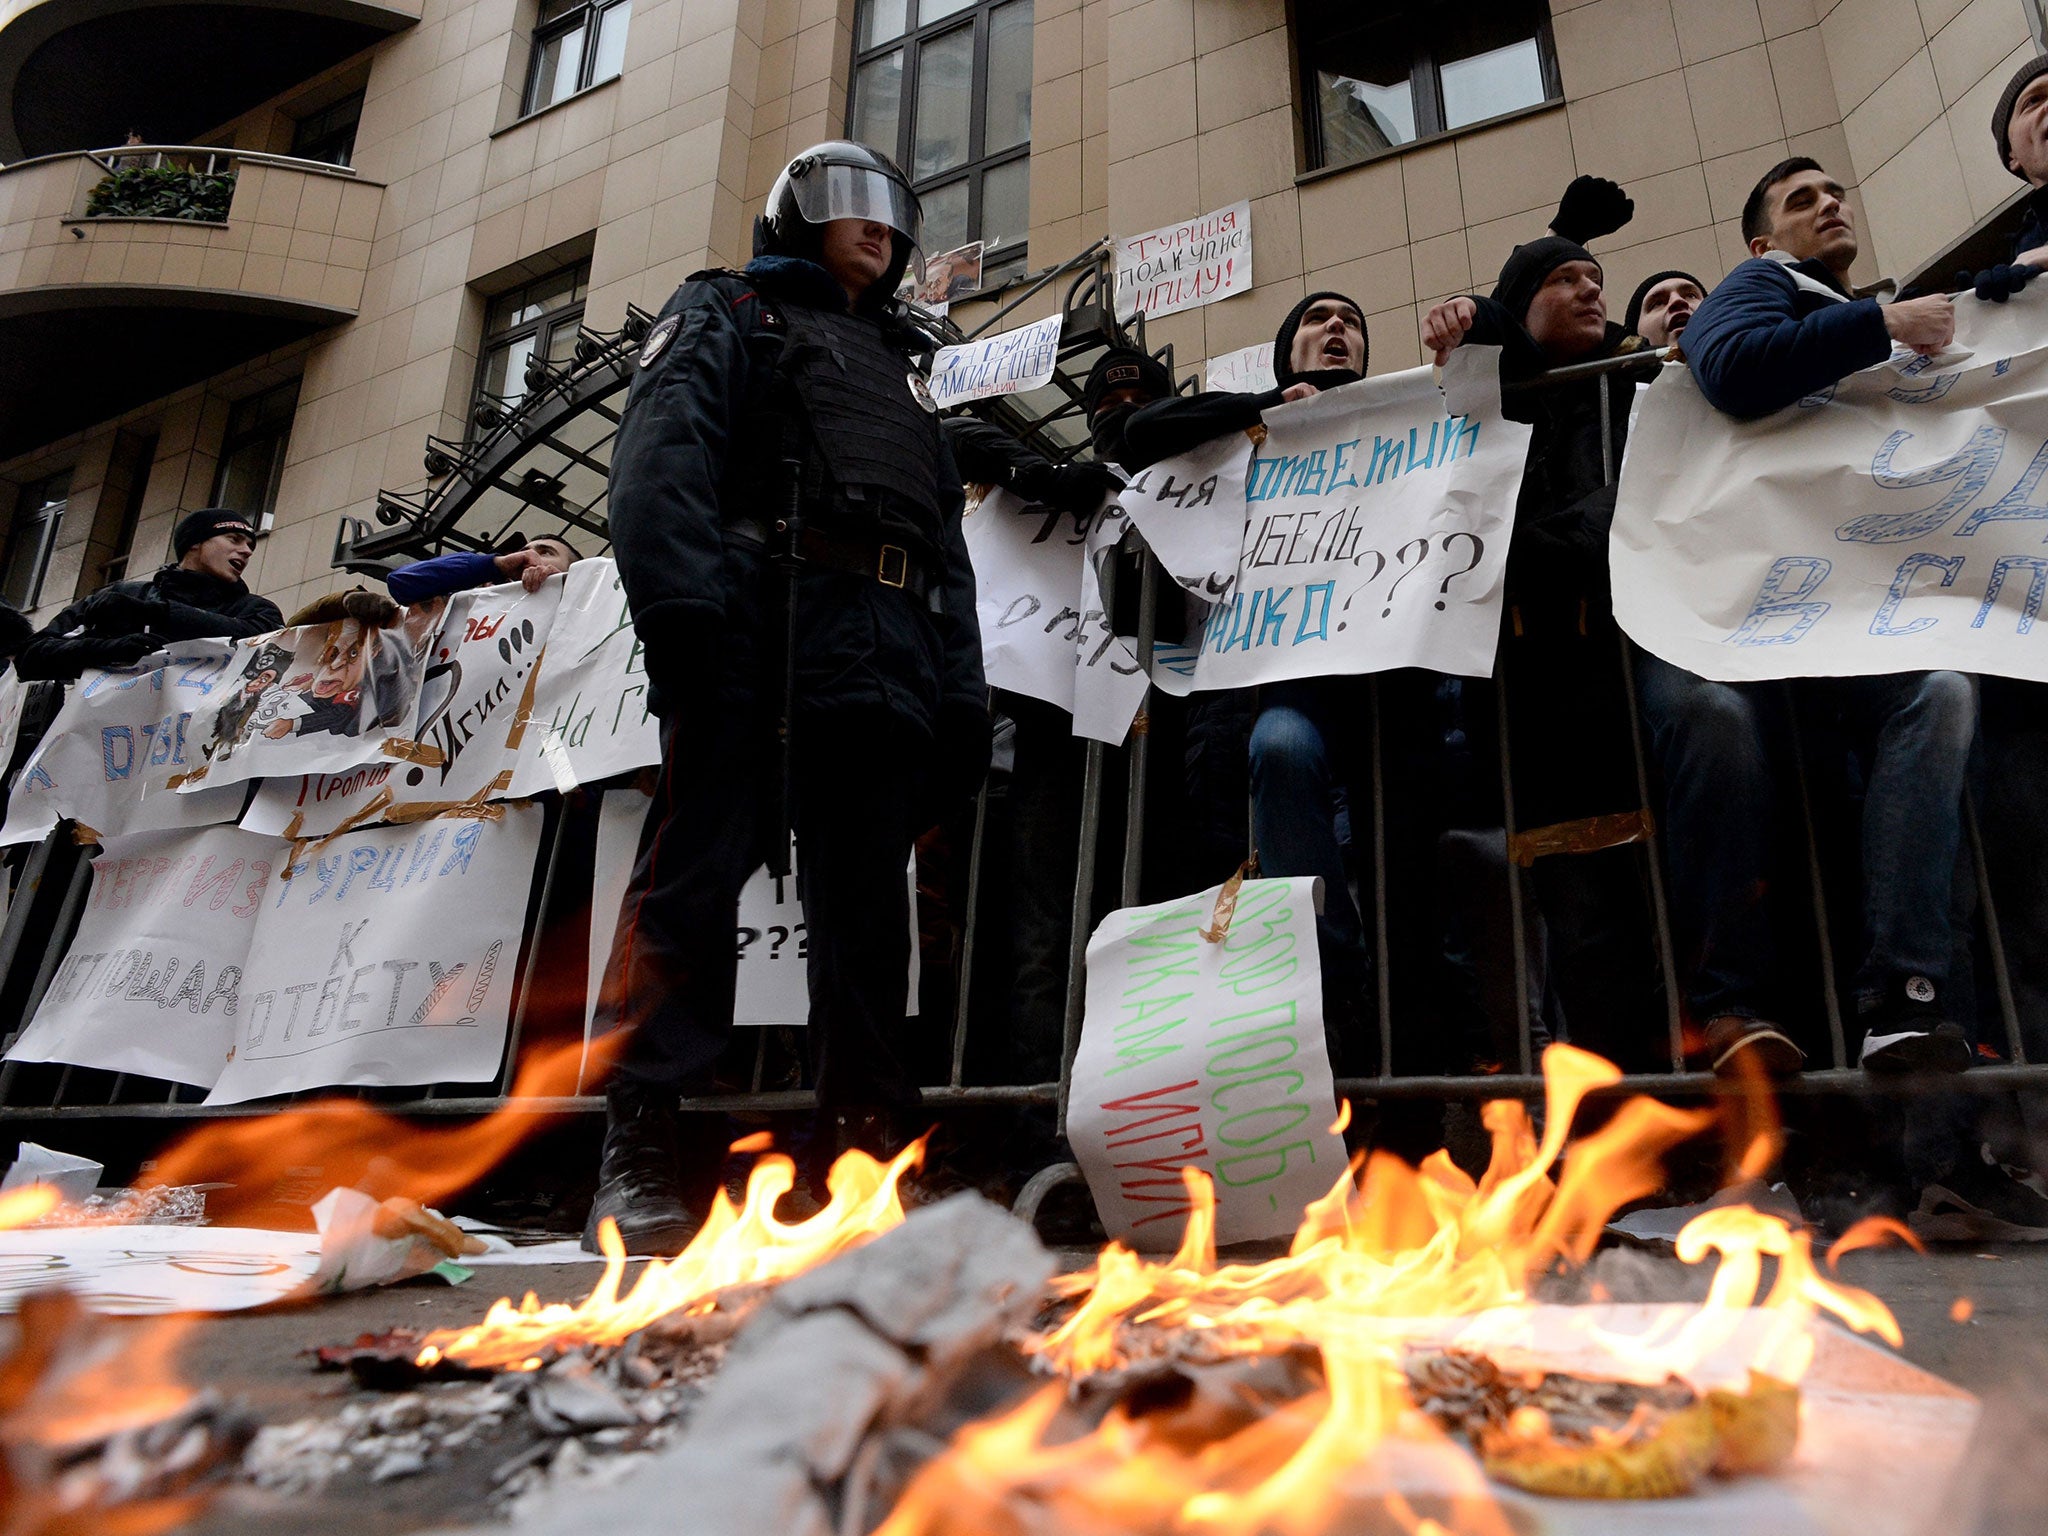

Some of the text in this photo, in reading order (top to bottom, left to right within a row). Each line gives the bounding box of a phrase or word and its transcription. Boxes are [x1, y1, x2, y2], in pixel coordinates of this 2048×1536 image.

[1127, 211, 1236, 263] ТУРЦИЯ
[1134, 257, 1233, 313] ИГИЛУ!
[1723, 556, 1832, 647] В
[539, 691, 597, 758] На
[275, 822, 485, 909] ТУРЦИЯ
[328, 917, 370, 976] К
[246, 938, 503, 1052] ОТВЕТУ!
